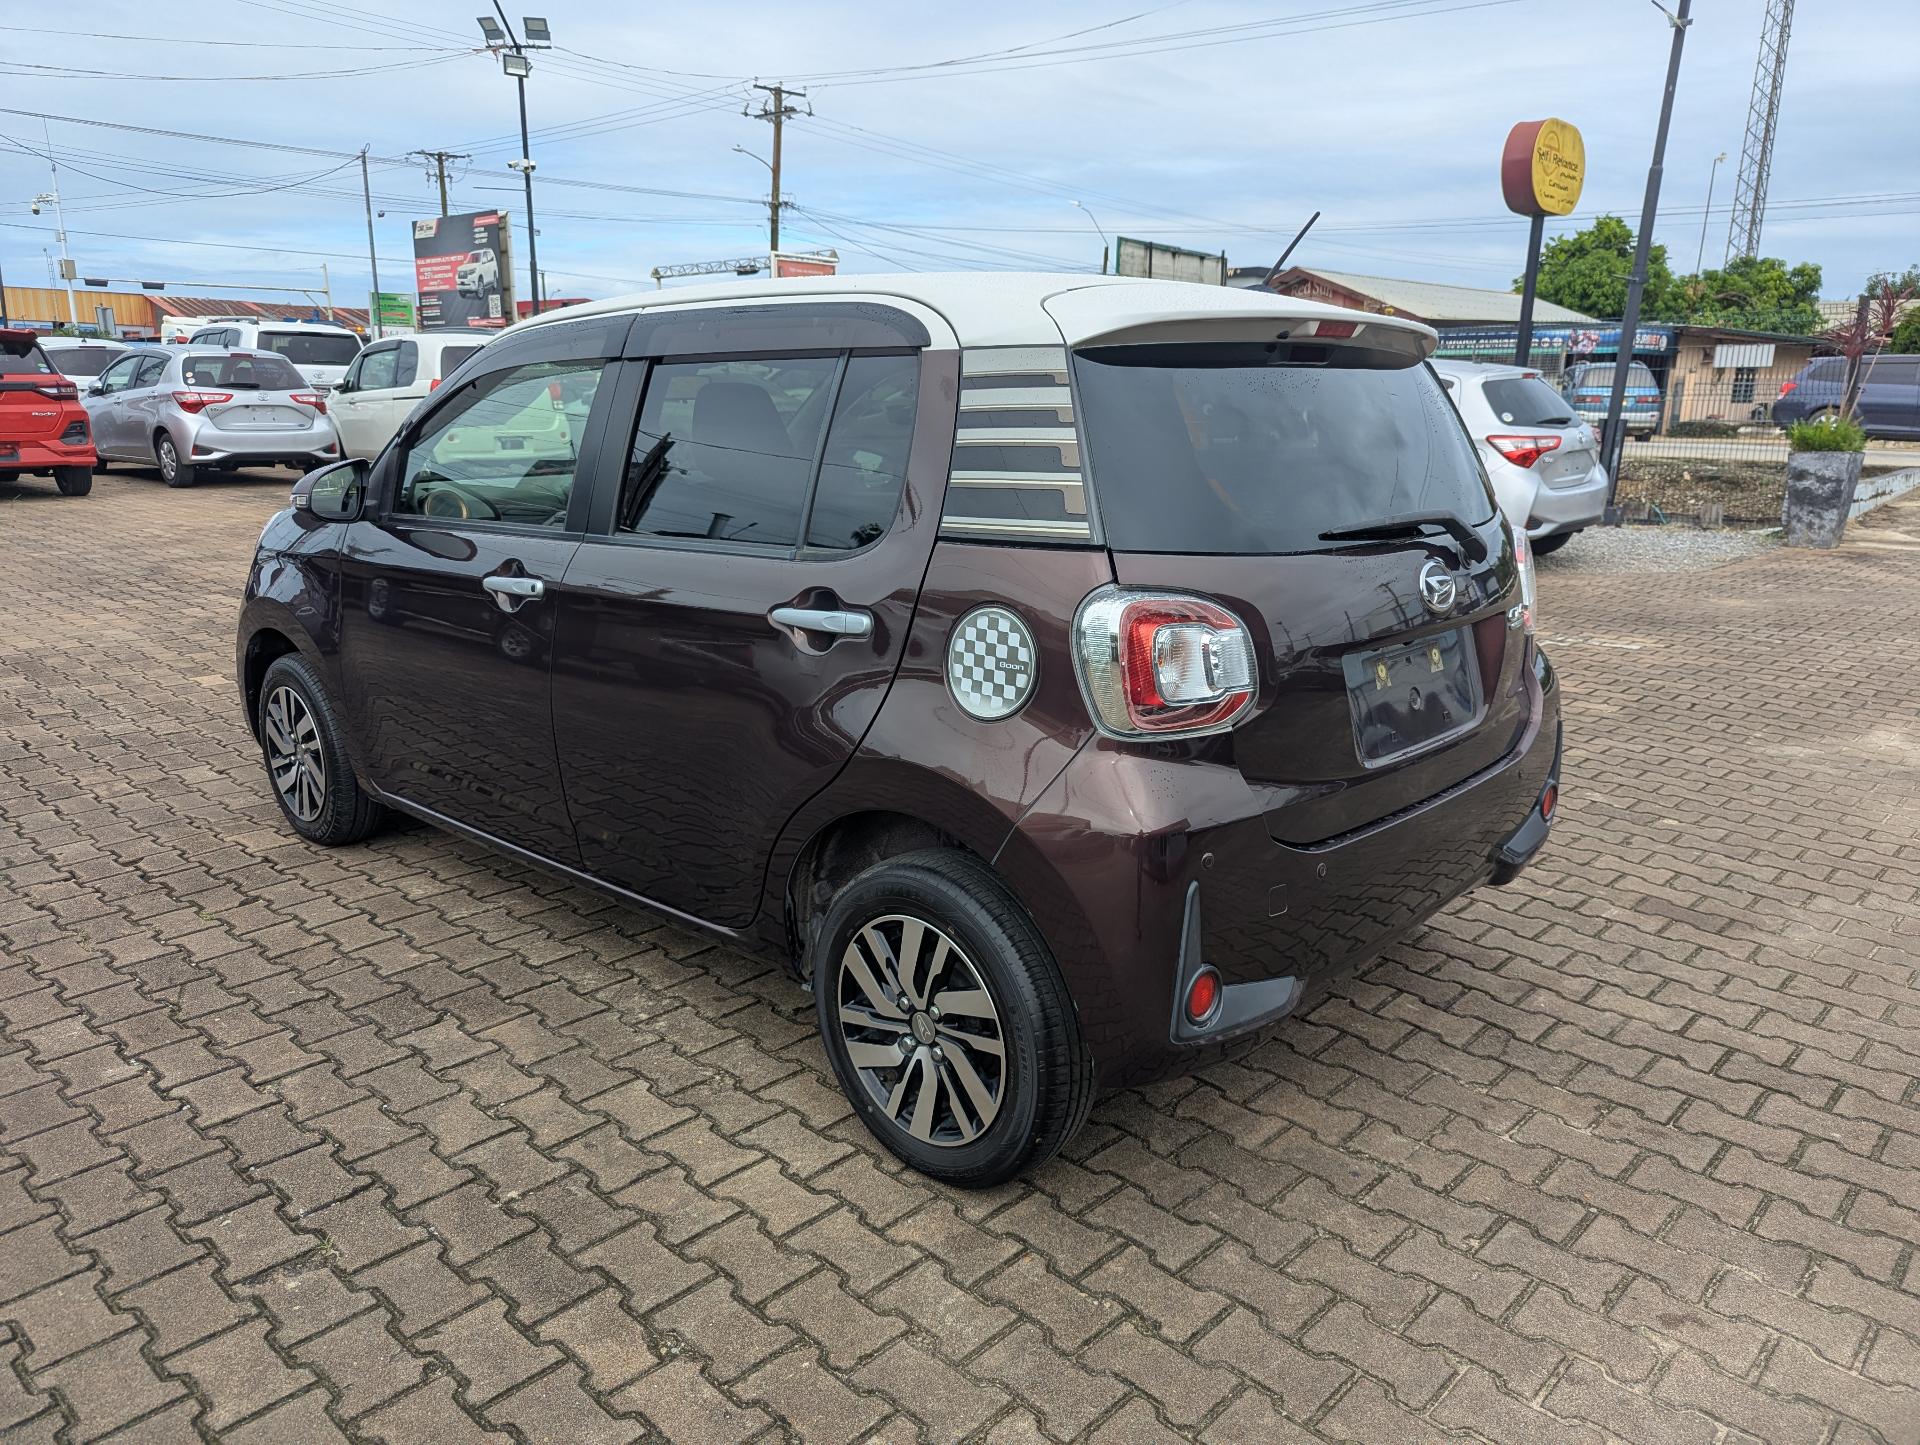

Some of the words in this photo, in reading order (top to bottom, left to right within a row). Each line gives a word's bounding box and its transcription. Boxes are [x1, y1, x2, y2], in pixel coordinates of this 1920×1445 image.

[1290, 280, 1311, 298] Red
[1312, 284, 1333, 299] Sun
[999, 661, 1024, 671] Boon
